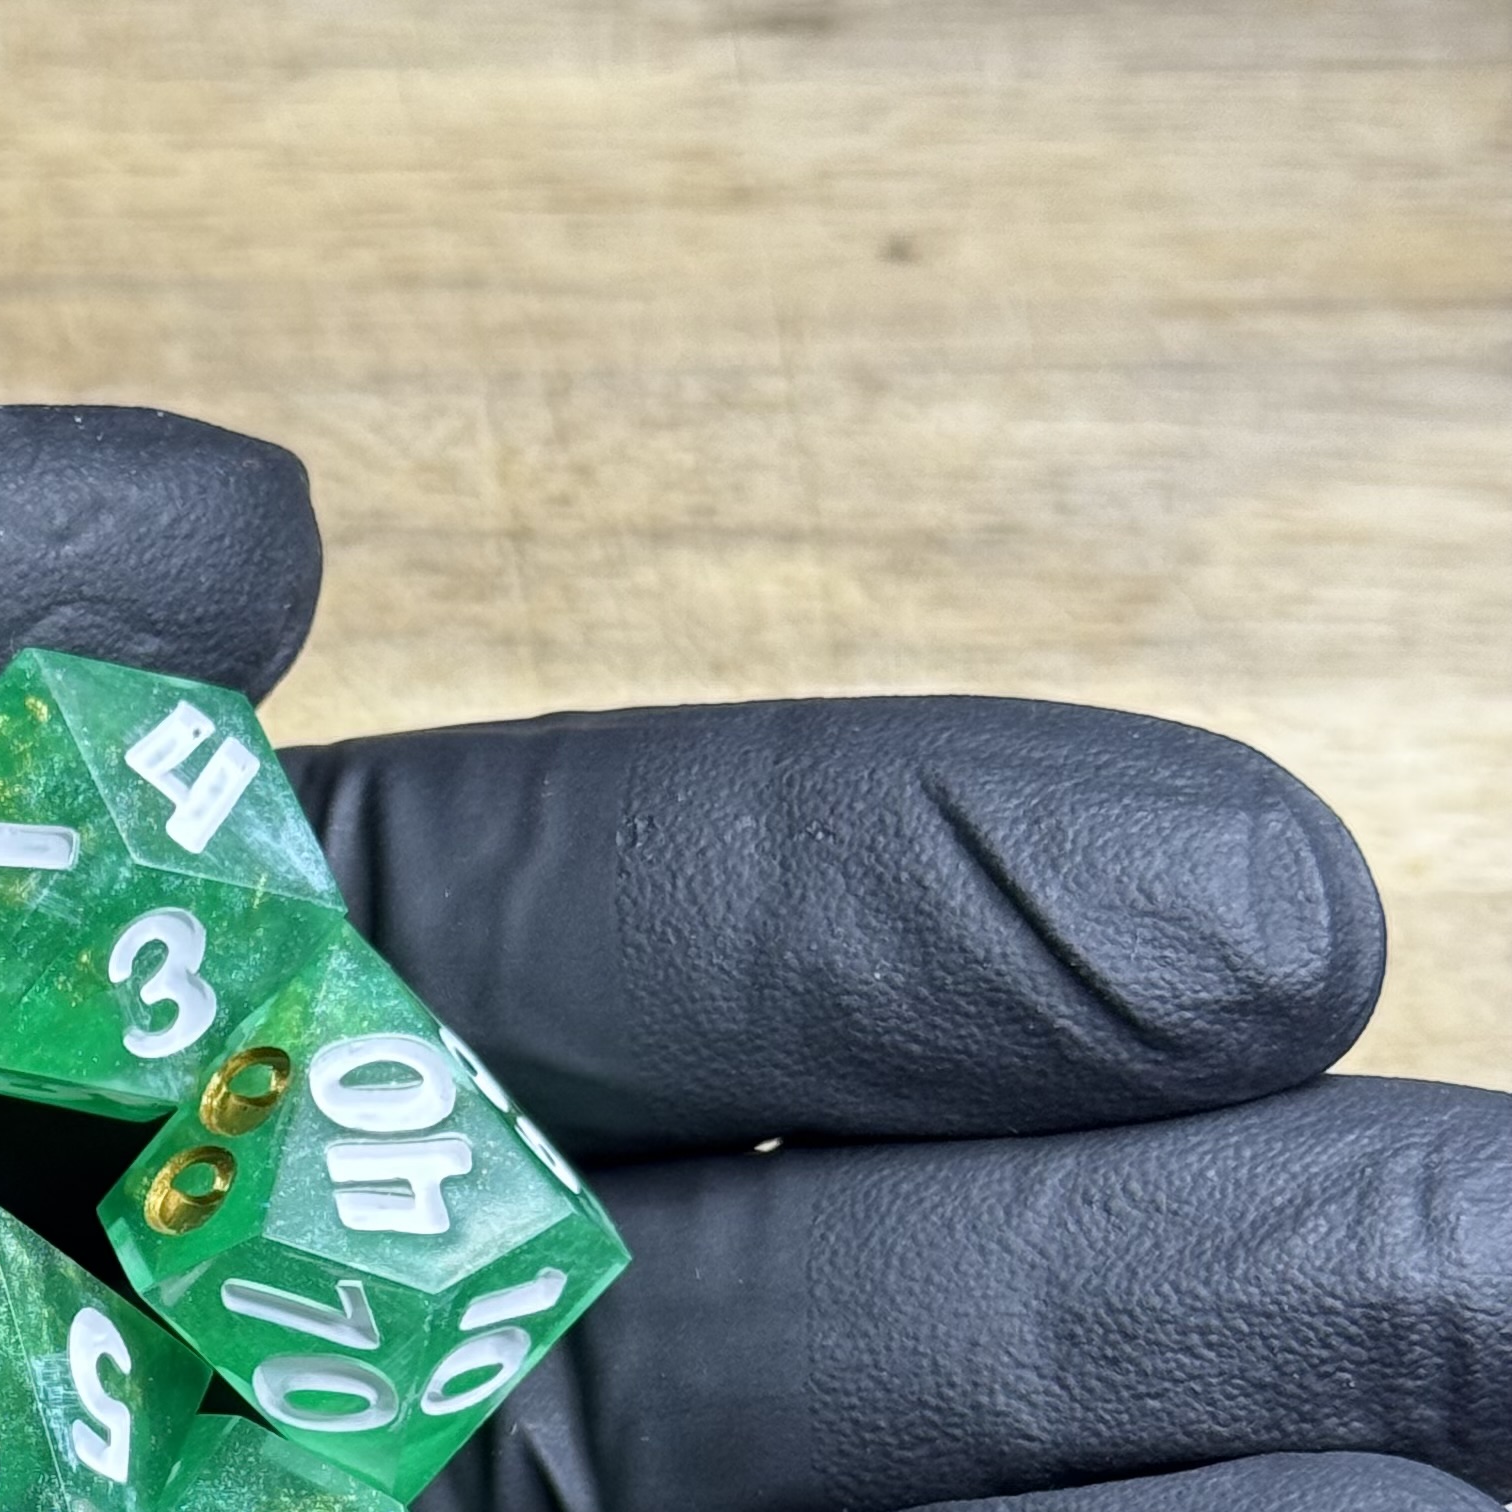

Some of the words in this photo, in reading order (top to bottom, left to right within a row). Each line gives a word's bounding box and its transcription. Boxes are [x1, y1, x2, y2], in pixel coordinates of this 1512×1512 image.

[124, 700, 262, 854] 4
[108, 907, 218, 1059] 3
[144, 1046, 292, 1237] 00
[309, 1032, 474, 1236] 40
[67, 1306, 133, 1485] 5
[221, 1278, 400, 1433] 70
[420, 1267, 568, 1416] 10
